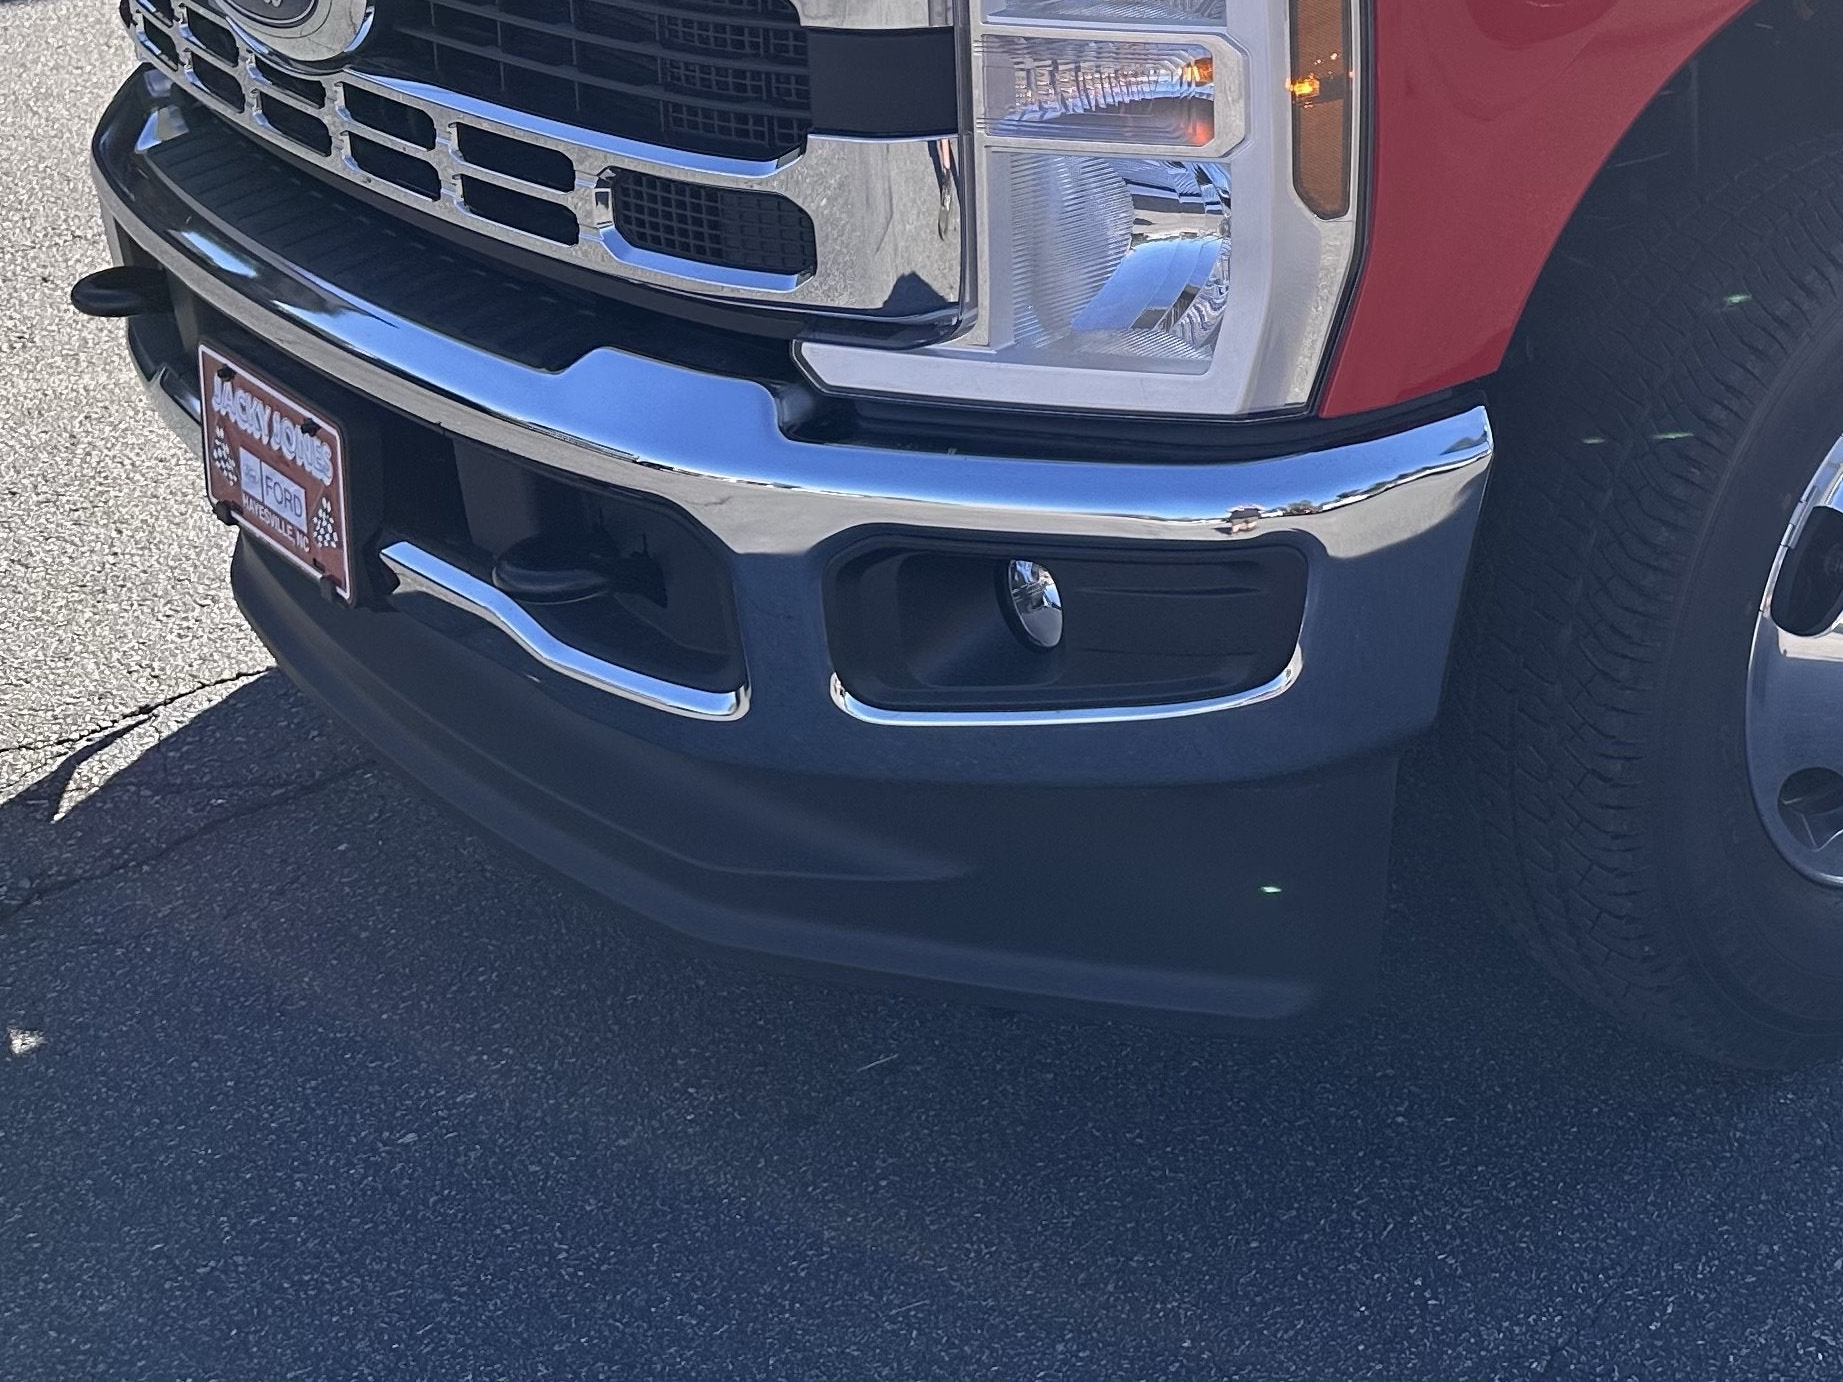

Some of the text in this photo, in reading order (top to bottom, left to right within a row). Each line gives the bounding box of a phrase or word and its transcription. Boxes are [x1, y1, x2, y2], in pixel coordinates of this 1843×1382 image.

[211, 375, 333, 486] JACKY JONES
[265, 474, 304, 519] FORD
[294, 529, 311, 553] NC
